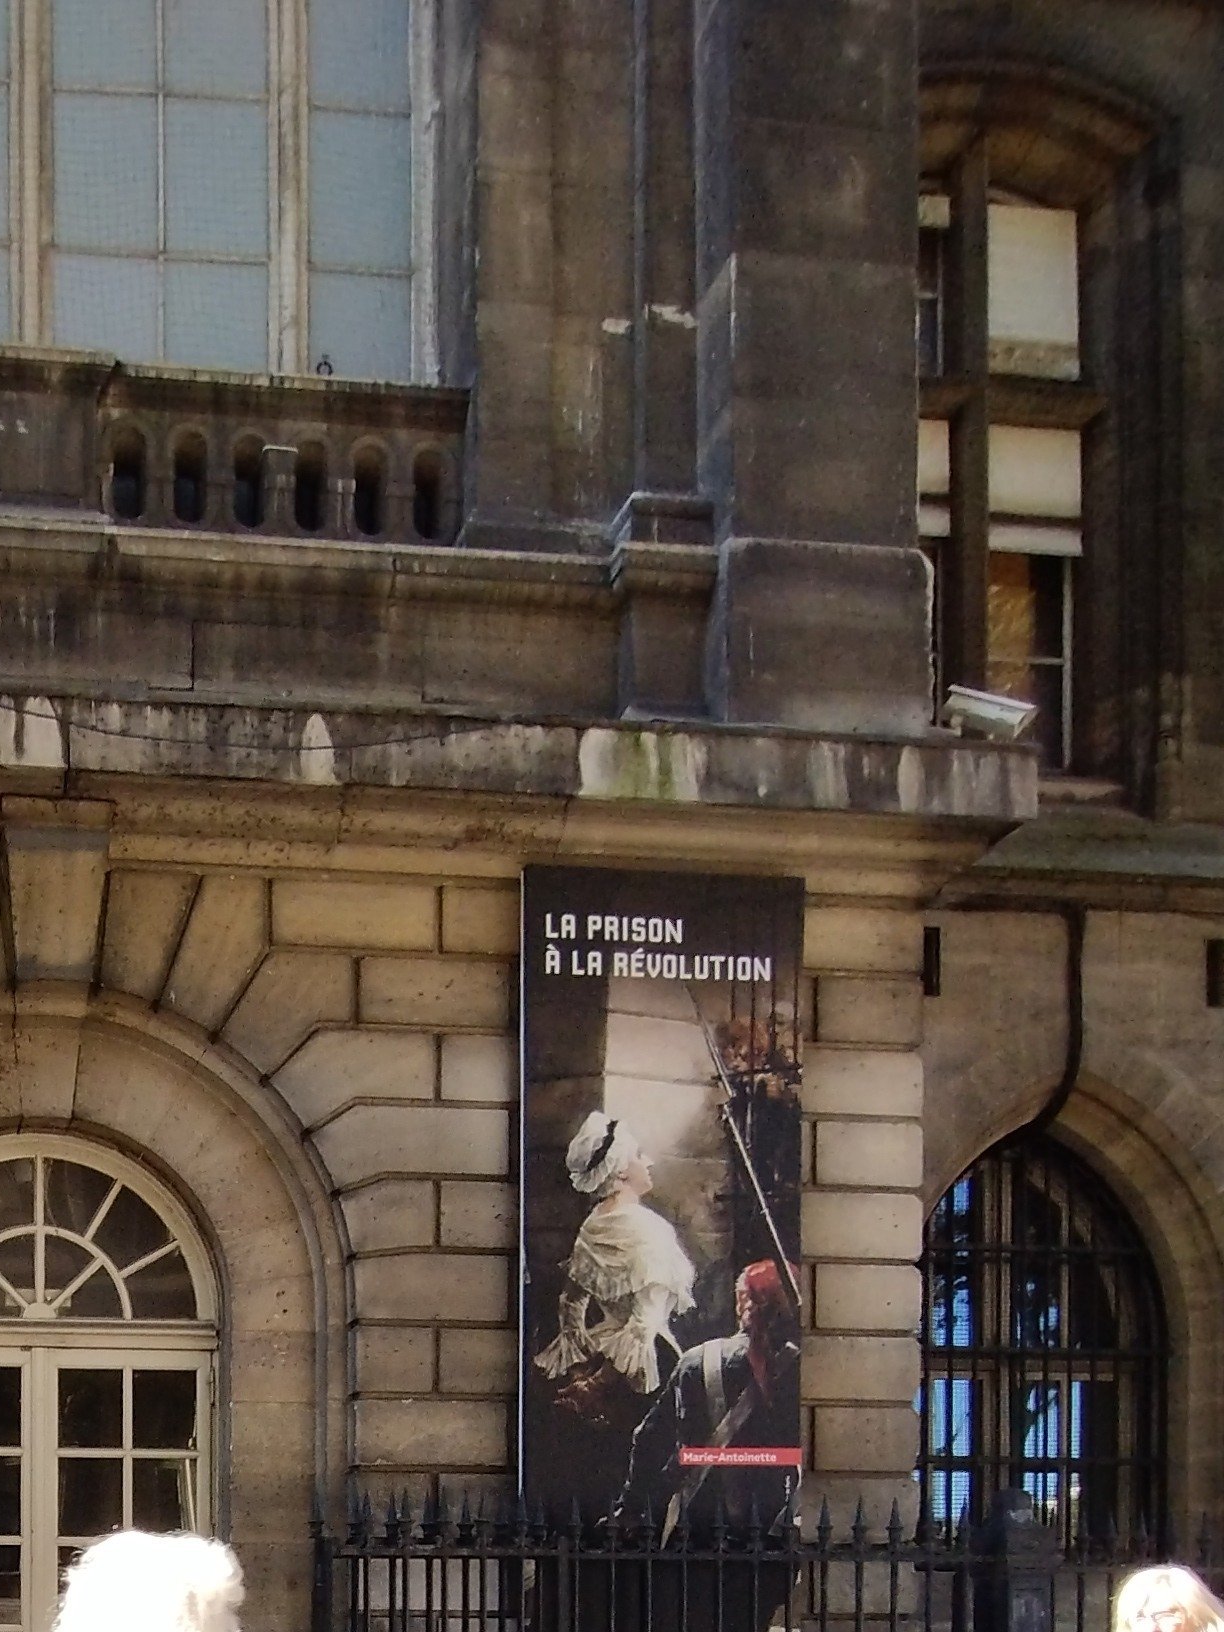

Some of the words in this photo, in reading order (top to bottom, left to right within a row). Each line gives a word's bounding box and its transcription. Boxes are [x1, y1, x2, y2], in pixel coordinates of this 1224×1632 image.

[545, 912, 576, 940] LA
[587, 914, 683, 944] PRISON
[545, 943, 561, 975] À
[572, 950, 602, 976] LA
[613, 948, 771, 981] RÉVOLUTION
[682, 1451, 778, 1463] Marie-Antoinette
